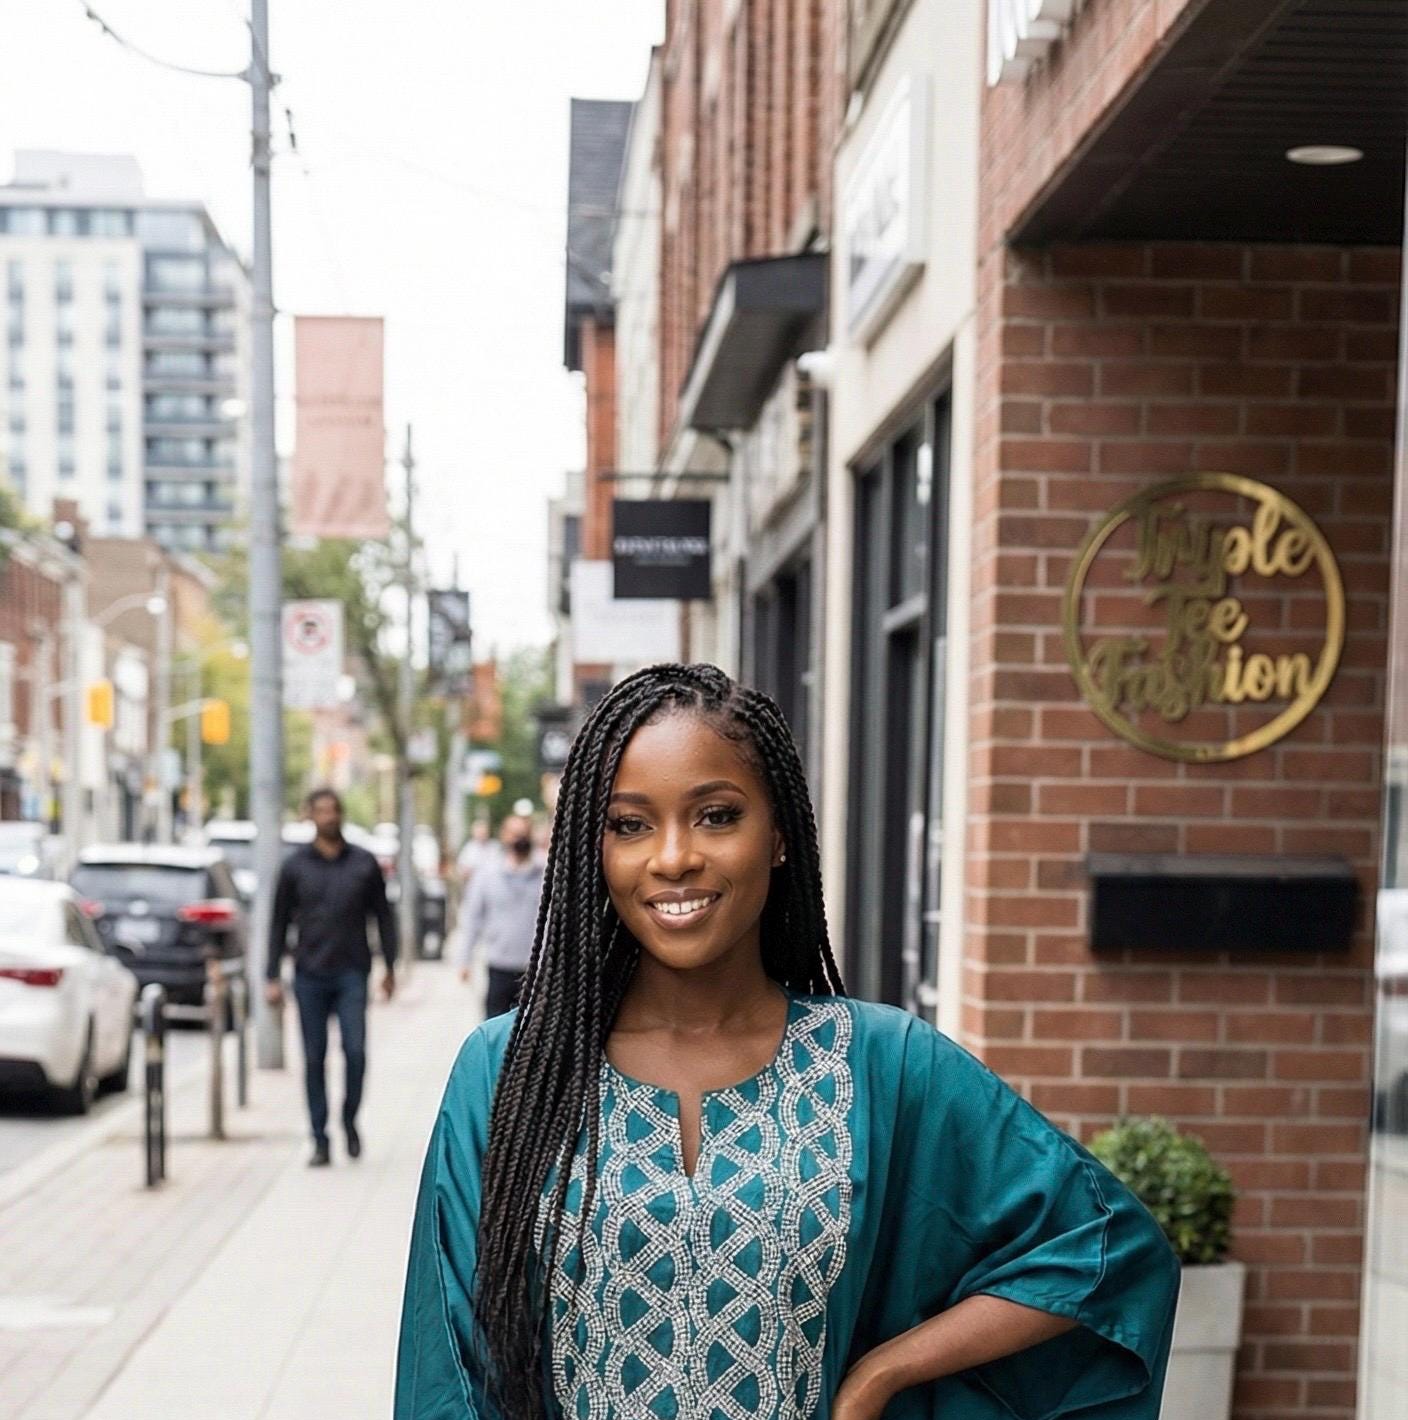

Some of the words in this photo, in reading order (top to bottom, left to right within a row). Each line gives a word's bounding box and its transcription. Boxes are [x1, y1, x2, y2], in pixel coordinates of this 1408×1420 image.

[1122, 499, 1314, 597] Triple
[1143, 585, 1249, 646] Tee
[1088, 639, 1312, 722] Fashion
